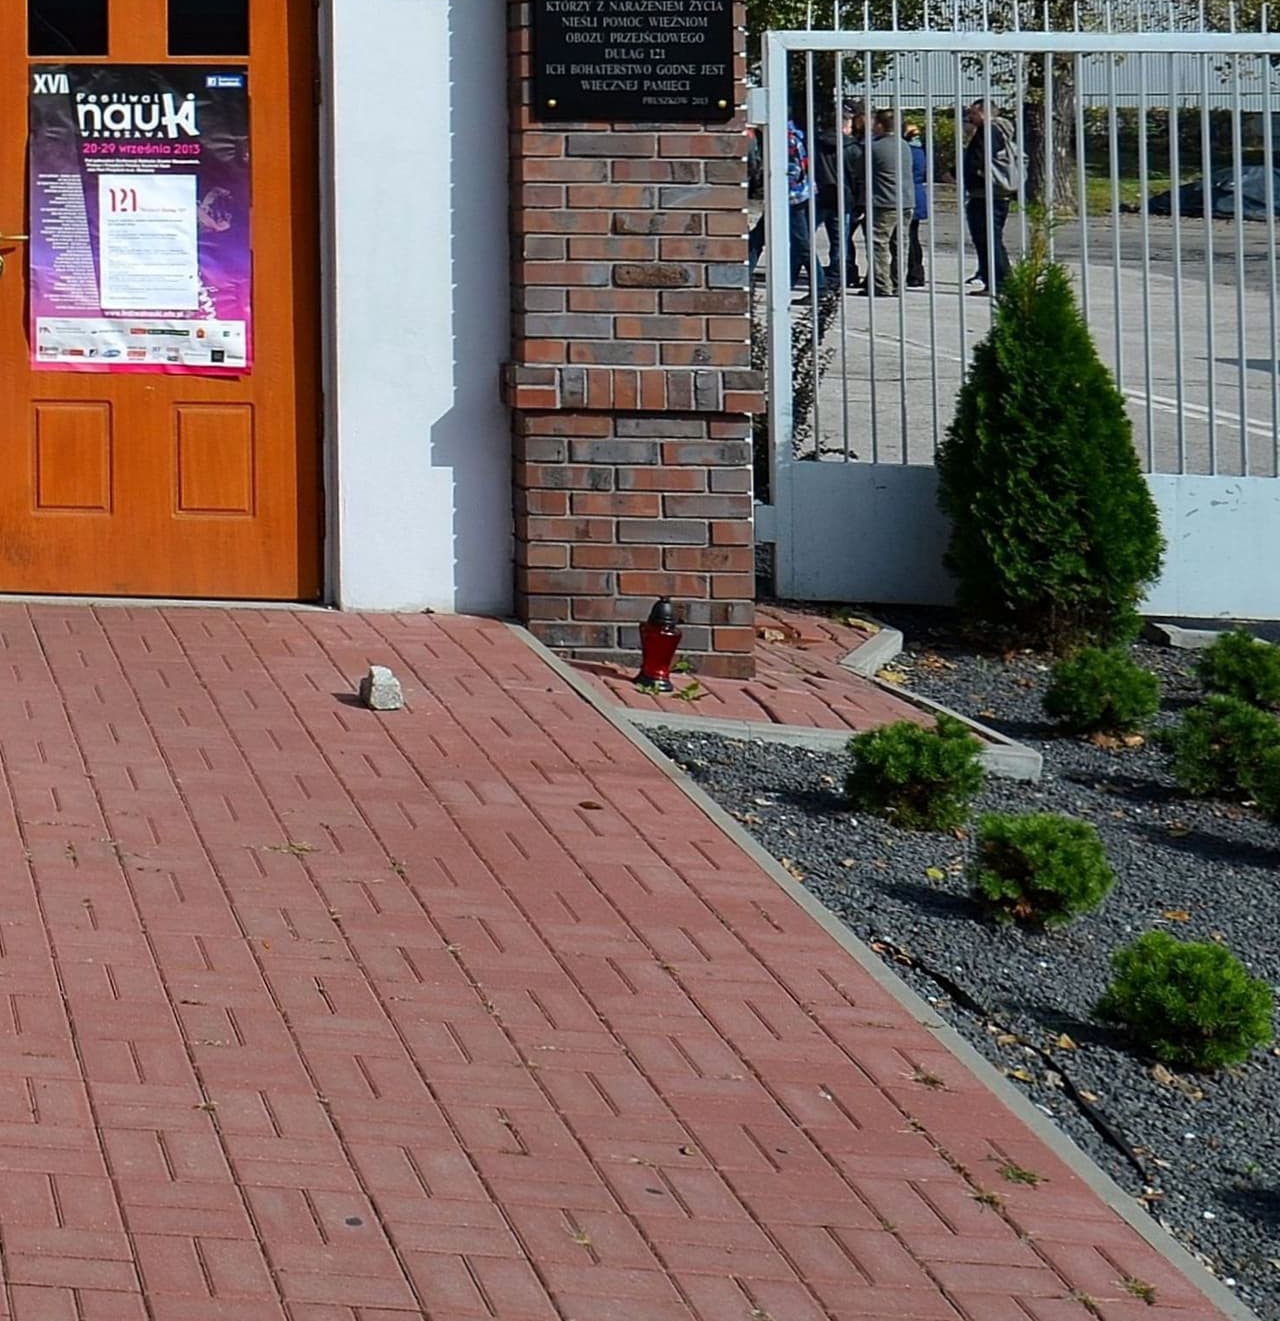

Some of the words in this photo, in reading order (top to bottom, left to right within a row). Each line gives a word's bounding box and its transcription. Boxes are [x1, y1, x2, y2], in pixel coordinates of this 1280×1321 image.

[546, 0, 591, 12] KTÓRZY
[597, 1, 605, 12] Z
[609, 0, 684, 12] NARAŻENIEM
[689, 0, 724, 12] ŻYCIA
[561, 15, 597, 28] NIEŚLI
[602, 16, 645, 28] POMOC
[565, 32, 606, 43] OBOZU
[610, 31, 705, 44] PRZEJŚCIOWEGO
[604, 48, 644, 59] DULAG
[649, 49, 666, 59] 121
[546, 64, 566, 75] ICH
[570, 64, 652, 75] BOHATERSTWO
[656, 64, 696, 75] GODNE
[700, 64, 726, 75] JEST
[581, 80, 638, 91] WIECZNEJ
[643, 80, 690, 92] PAMIĘCI
[75, 93, 160, 103] Festiwal
[77, 93, 200, 139] nauki
[82, 143, 116, 155] 20-29
[119, 143, 171, 155] września
[173, 143, 201, 155] 2013
